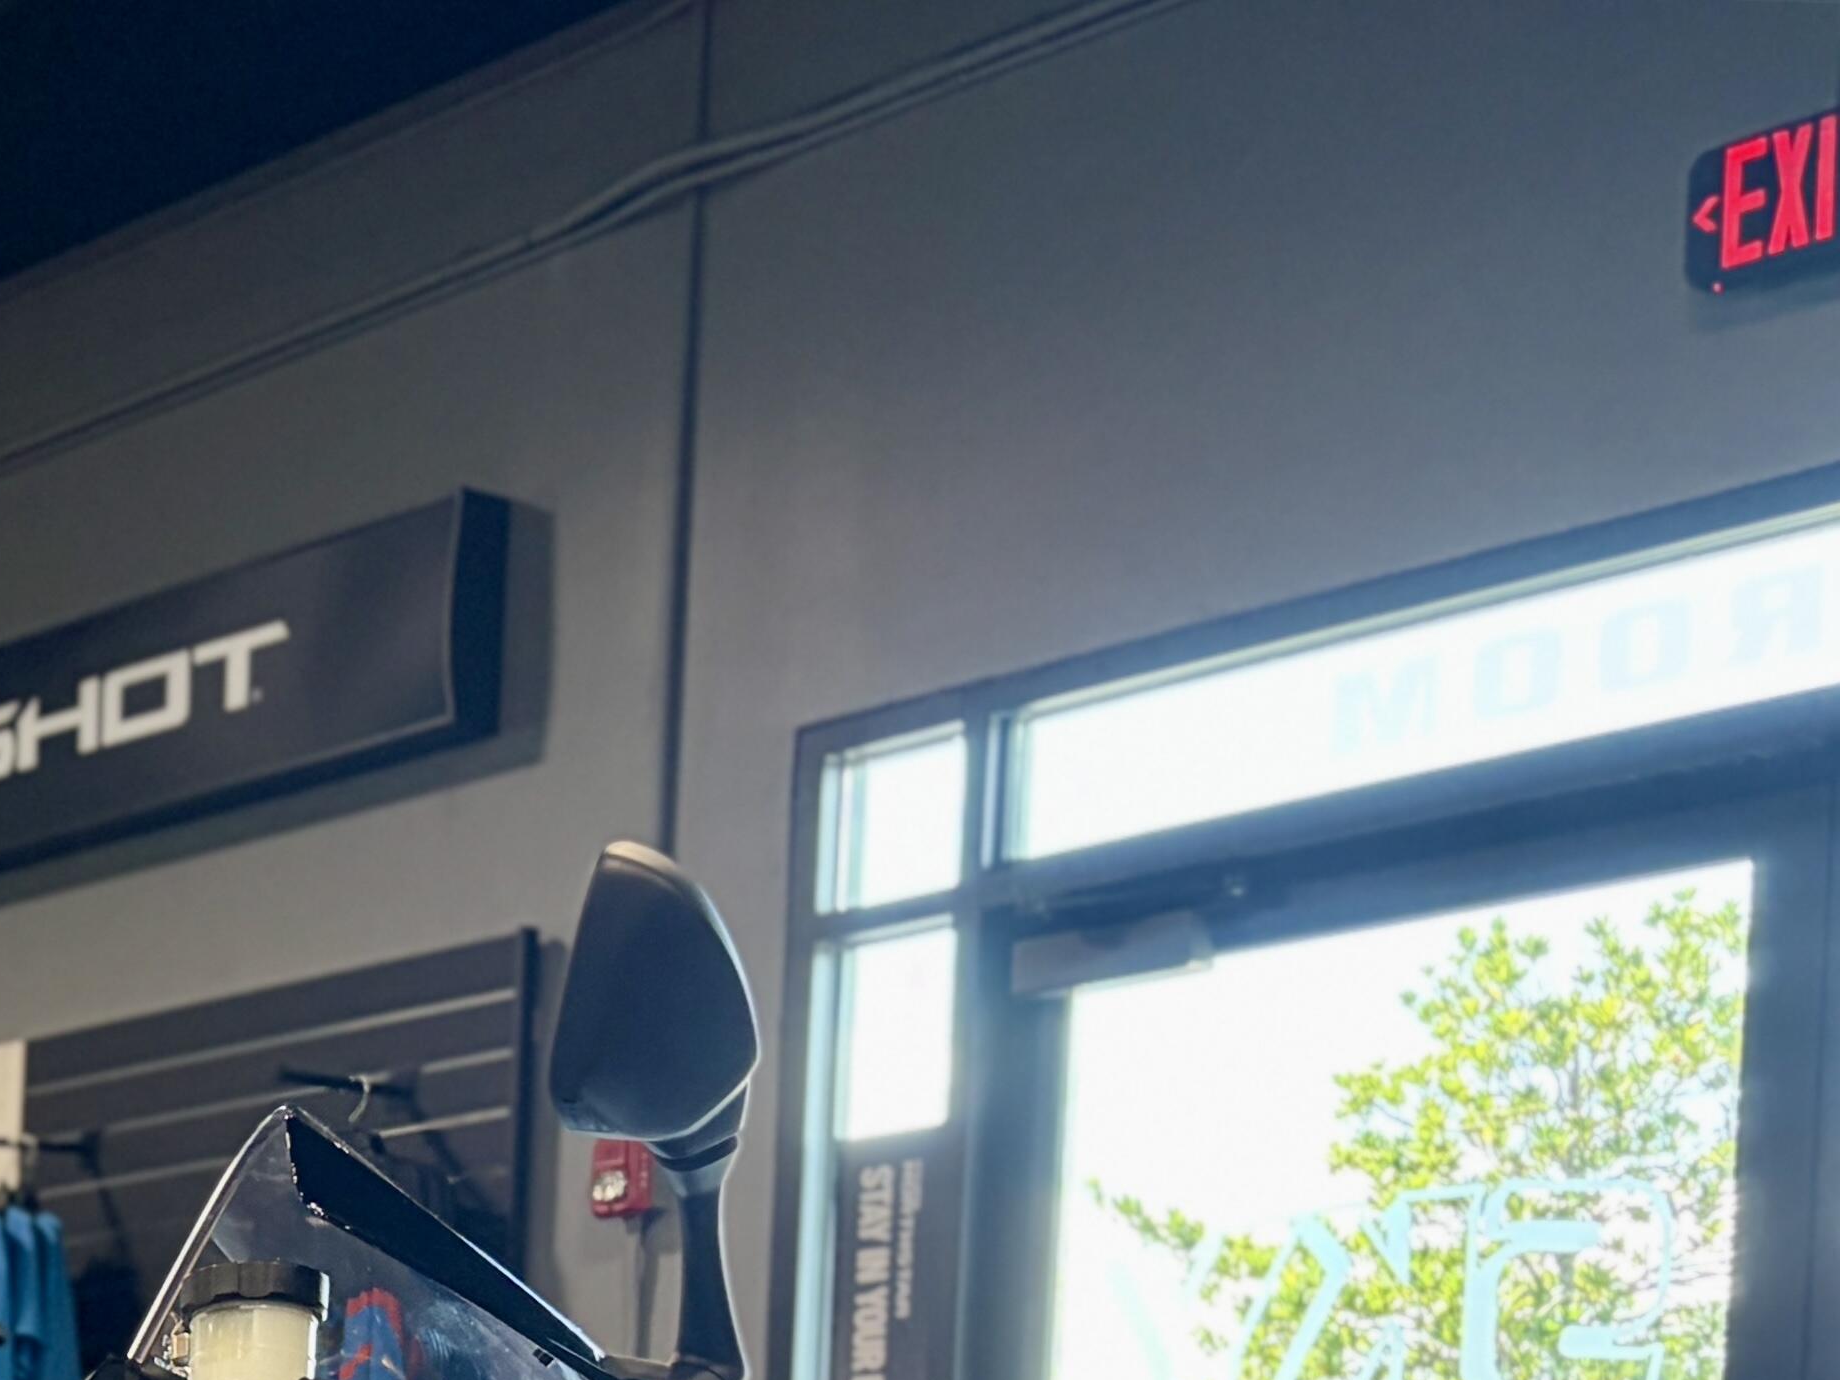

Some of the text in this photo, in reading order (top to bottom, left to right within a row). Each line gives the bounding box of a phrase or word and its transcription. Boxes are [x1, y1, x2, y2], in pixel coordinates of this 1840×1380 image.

[856, 1163, 894, 1241] STAY
[854, 1249, 890, 1285] IN
[850, 1288, 889, 1372] YOUR
